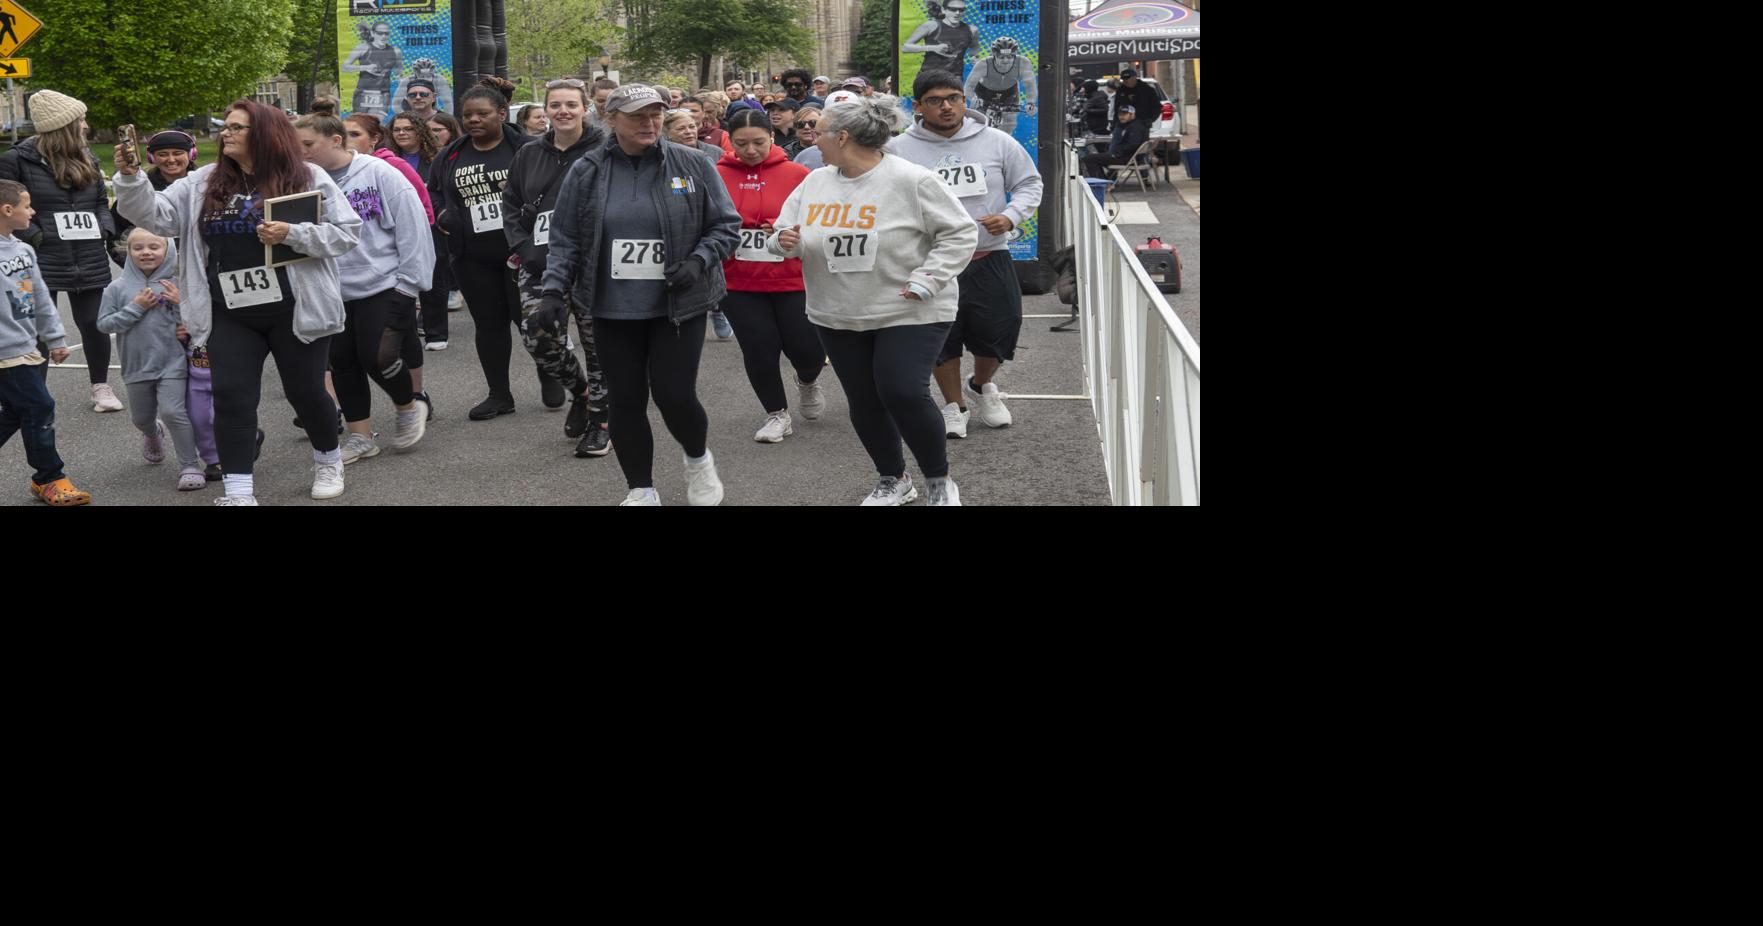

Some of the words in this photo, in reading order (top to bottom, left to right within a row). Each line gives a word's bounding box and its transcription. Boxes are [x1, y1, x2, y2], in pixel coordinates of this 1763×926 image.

[985, 14, 1006, 24] FOR
[406, 37, 423, 46] FOR
[455, 163, 485, 177] DON'T
[938, 165, 976, 186] 279
[455, 173, 486, 188] LEAVE
[458, 183, 491, 197] BRAIN
[464, 197, 477, 207] ON
[479, 192, 503, 203] SHU
[478, 203, 503, 221] 19
[806, 203, 877, 229] VOLS
[62, 213, 93, 229] 140
[741, 231, 765, 249] 26
[829, 233, 868, 257] 277
[621, 242, 665, 264] 278
[229, 269, 270, 294] 143
